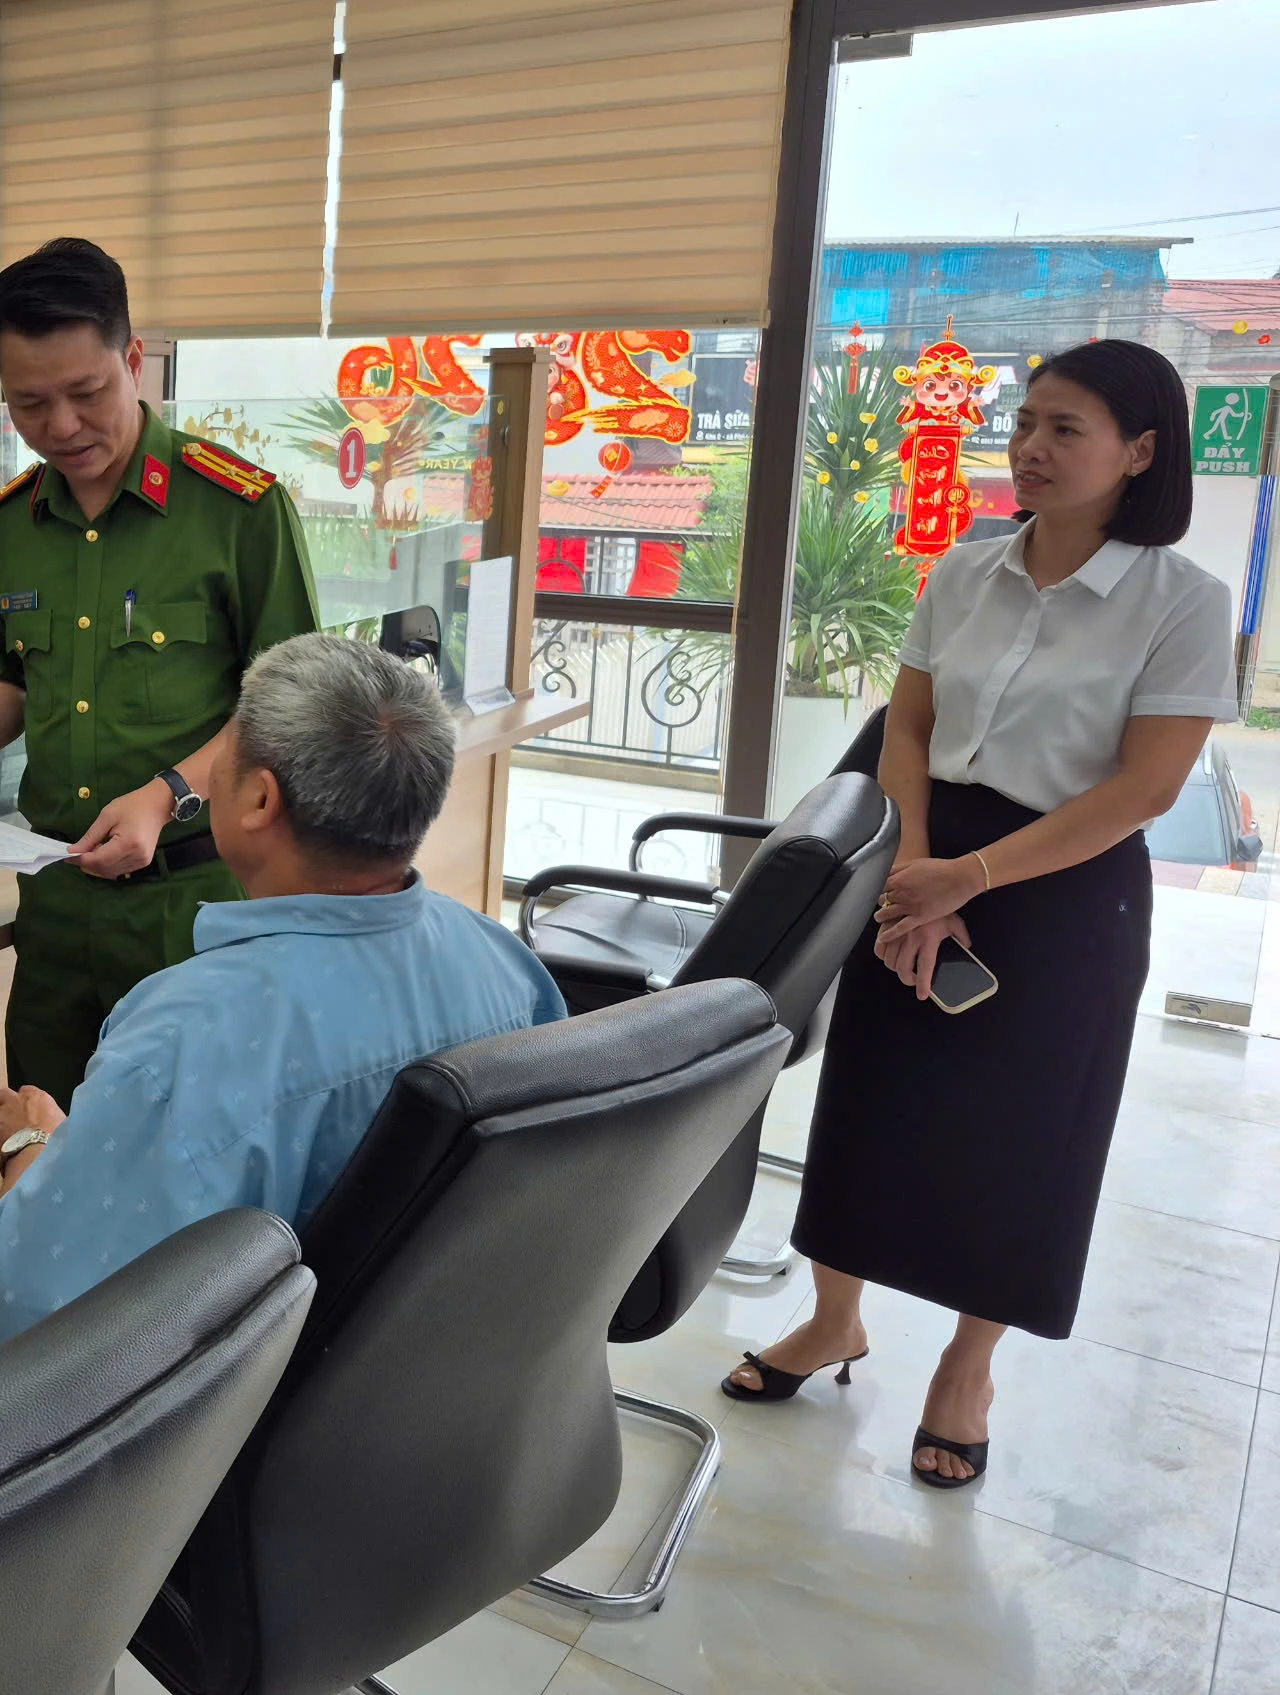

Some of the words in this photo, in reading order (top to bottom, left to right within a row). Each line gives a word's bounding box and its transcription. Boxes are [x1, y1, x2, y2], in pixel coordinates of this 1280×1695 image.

[1204, 442, 1246, 458] ĐẨY
[345, 439, 358, 479] 1
[1195, 461, 1251, 473] PUSH
